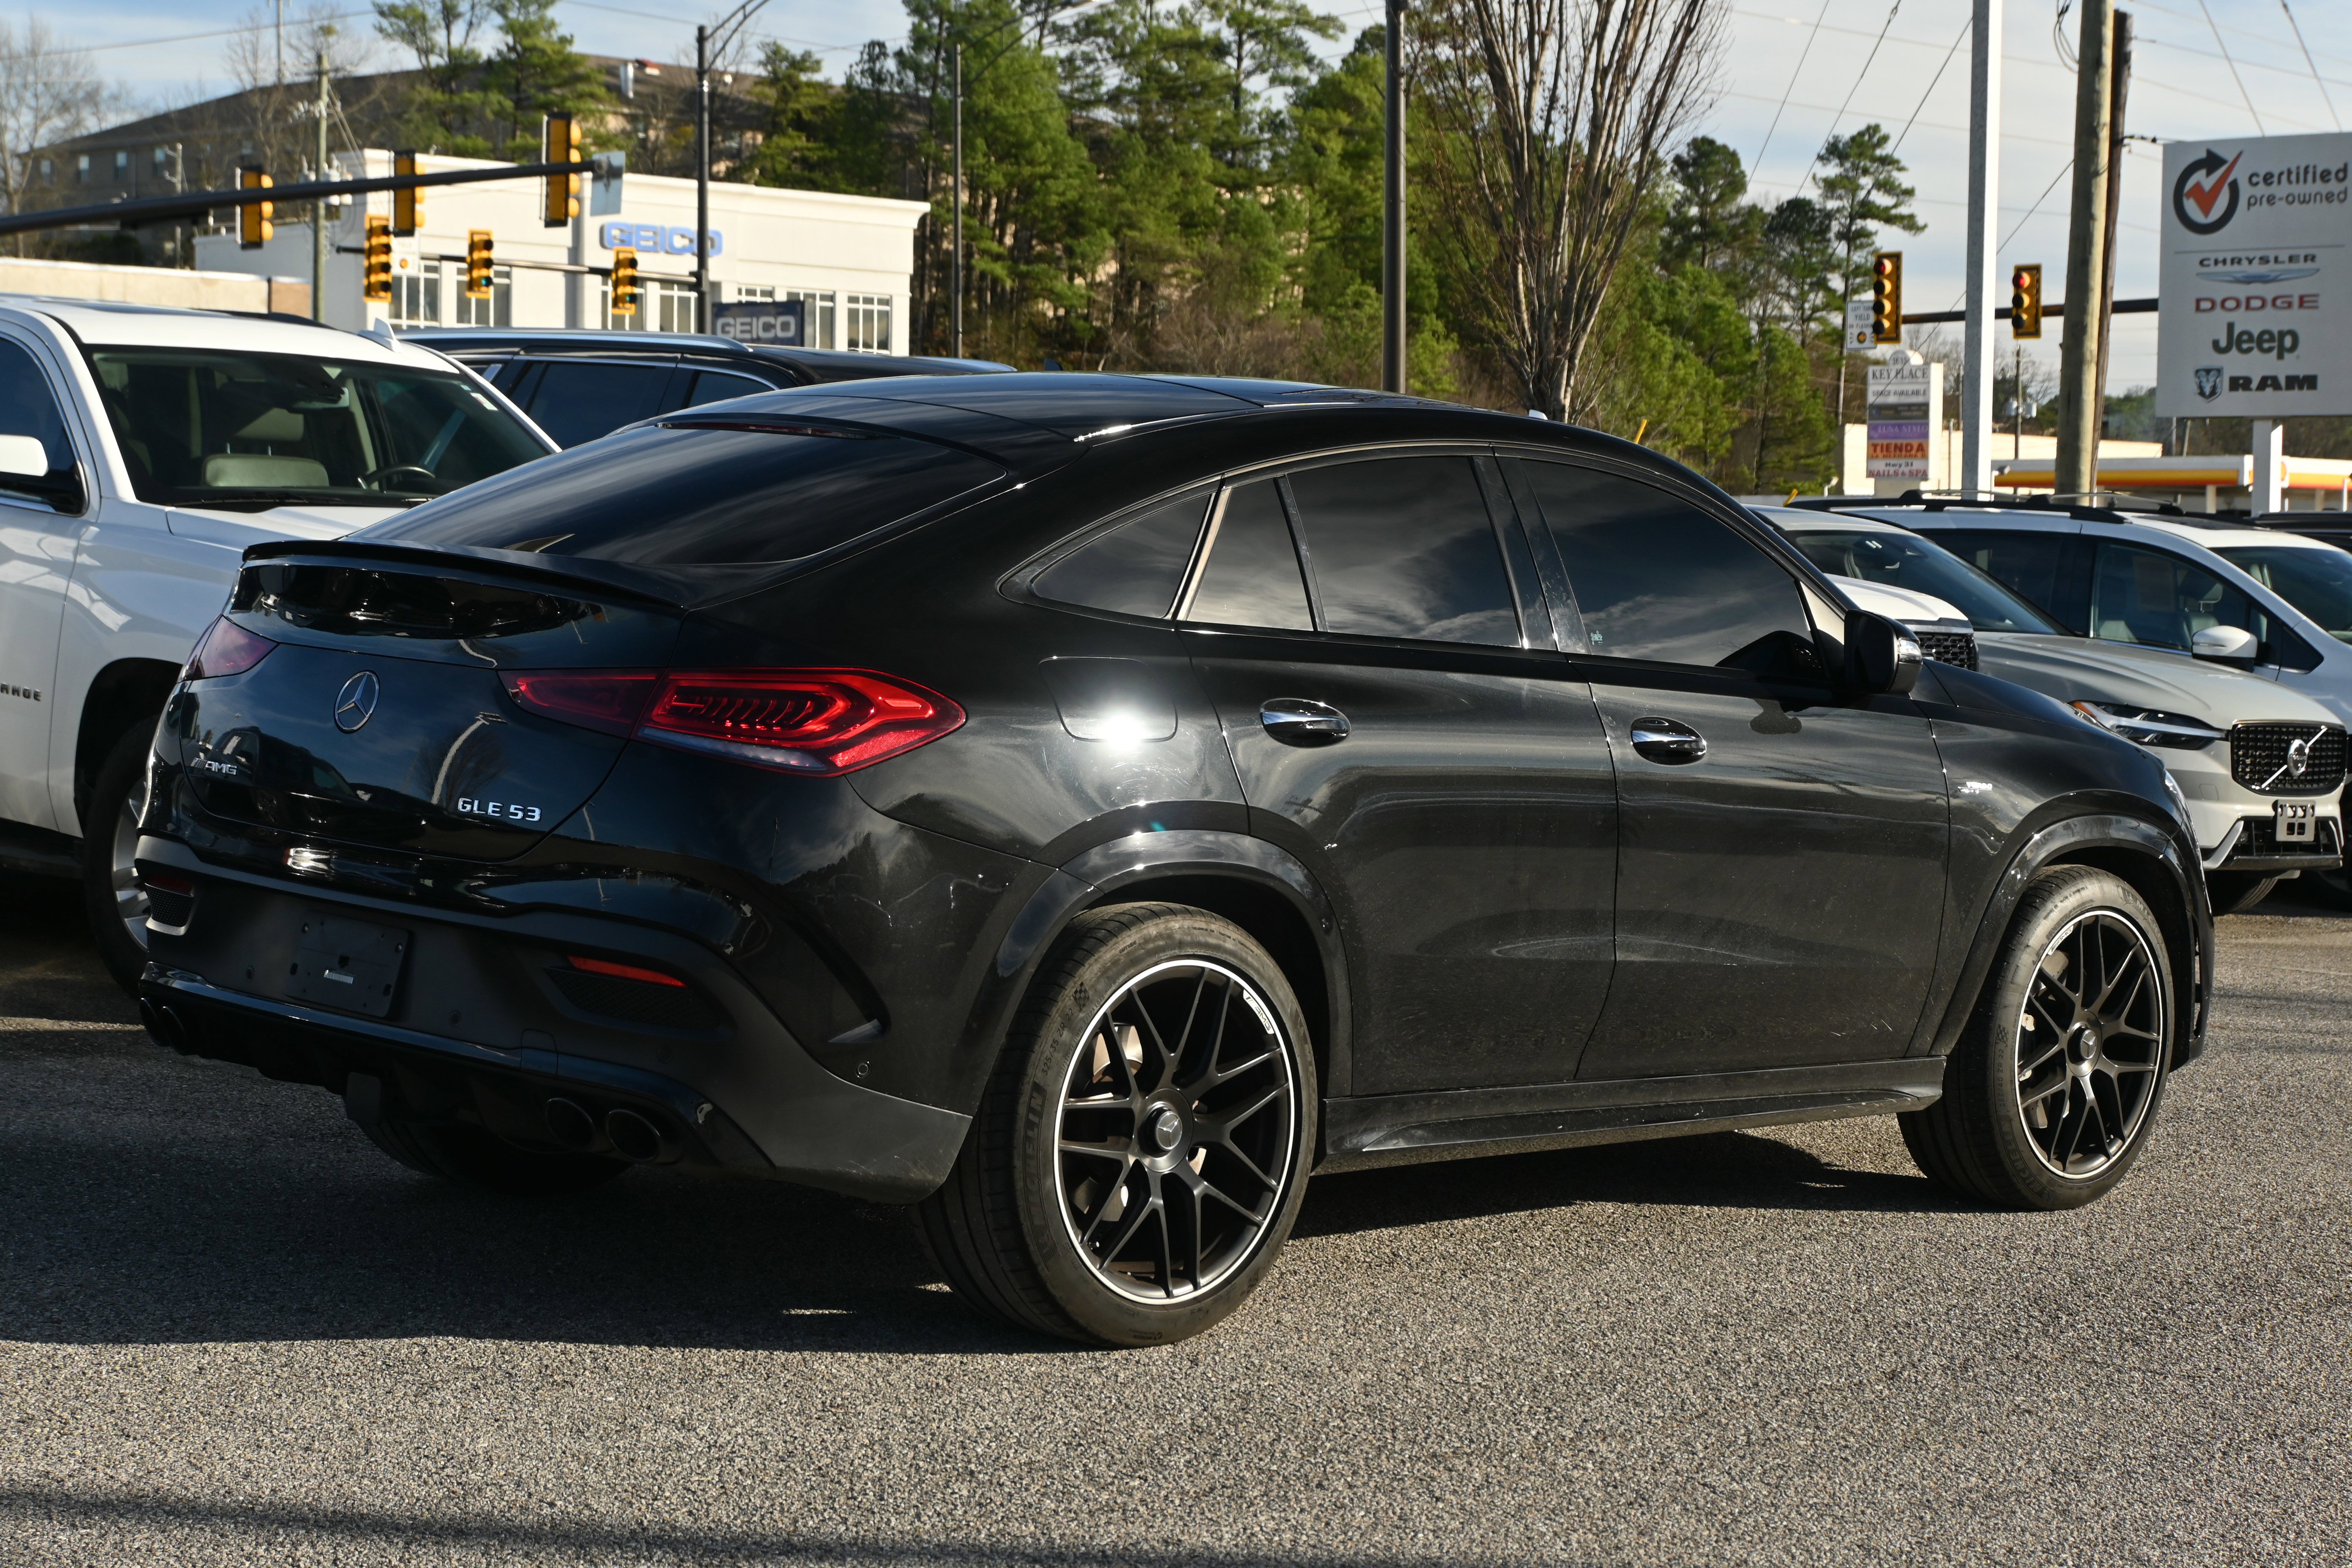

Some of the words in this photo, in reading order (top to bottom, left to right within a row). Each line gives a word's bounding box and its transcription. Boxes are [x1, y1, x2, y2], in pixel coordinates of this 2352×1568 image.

[2248, 162, 2348, 187] certified
[2247, 187, 2348, 211] pre-owned
[602, 221, 723, 257] GEICO
[2199, 254, 2317, 267] CHRYSLER
[2195, 294, 2319, 313] DODGE
[716, 315, 796, 339] GEICO
[2212, 322, 2300, 360] Jeep
[1872, 369, 1892, 380] KEY
[1895, 368, 1928, 379] PLACE
[2229, 375, 2318, 392] RAM
[1871, 442, 1926, 453] TIENDA
[1869, 469, 1900, 477] NAILS
[1908, 468, 1928, 476] SPA
[205, 760, 237, 776] AMG
[457, 797, 504, 817] GLE
[509, 804, 542, 822] 53
[1041, 1038, 1059, 1076] 325/35
[1056, 1021, 1067, 1037] ZR
[1065, 1008, 1075, 1021] 22
[1998, 1048, 2004, 1059] 22
[1997, 1061, 2004, 1074] ZR
[1997, 1076, 2005, 1107] 285/40
[1025, 1091, 1045, 1226] MICHELIN
